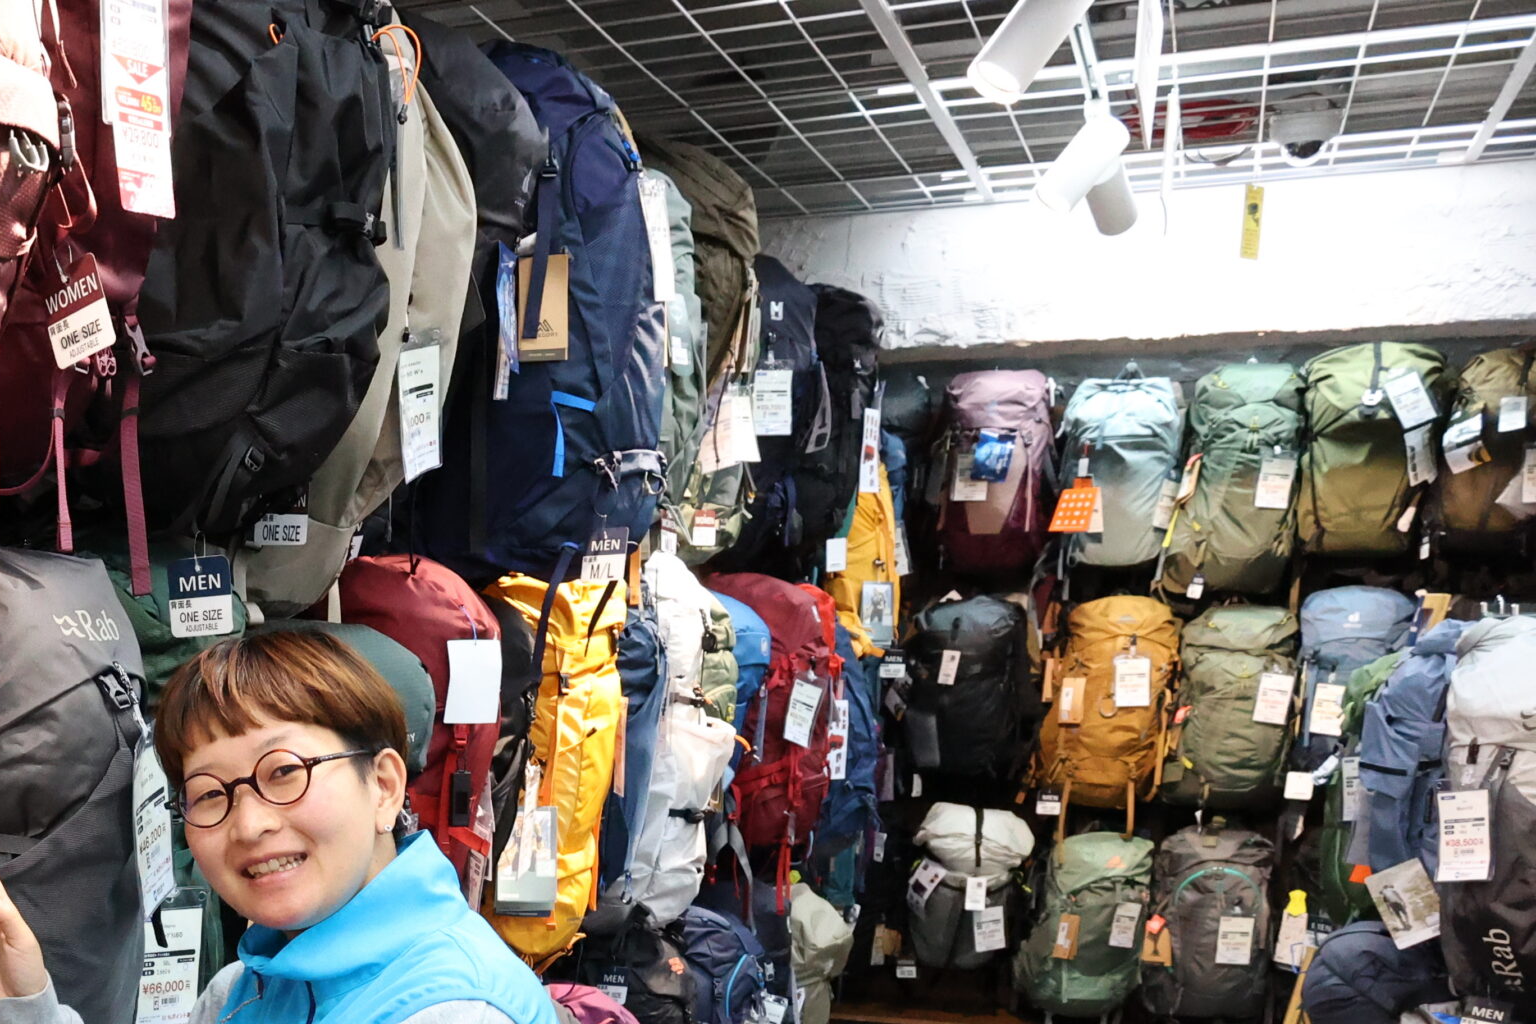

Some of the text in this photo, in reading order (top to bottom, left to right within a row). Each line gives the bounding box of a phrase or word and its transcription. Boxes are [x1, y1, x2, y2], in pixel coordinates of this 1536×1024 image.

[45, 272, 98, 316] WOMEN
[60, 318, 103, 350] ONE SIZE
[69, 337, 100, 359] ADJUSTABLE
[262, 524, 302, 542] ONE SIZE
[590, 538, 621, 552] MEN
[589, 563, 615, 580] M/L
[178, 573, 222, 592] MEN
[179, 609, 223, 623] ONE SIZE
[74, 609, 120, 642] Rab
[185, 622, 219, 632] ADJUSTABLE
[1482, 928, 1523, 978] Rab
[142, 979, 184, 995] ¥66,000
[603, 974, 625, 983] MEN
[1471, 1006, 1504, 1021] MEN
